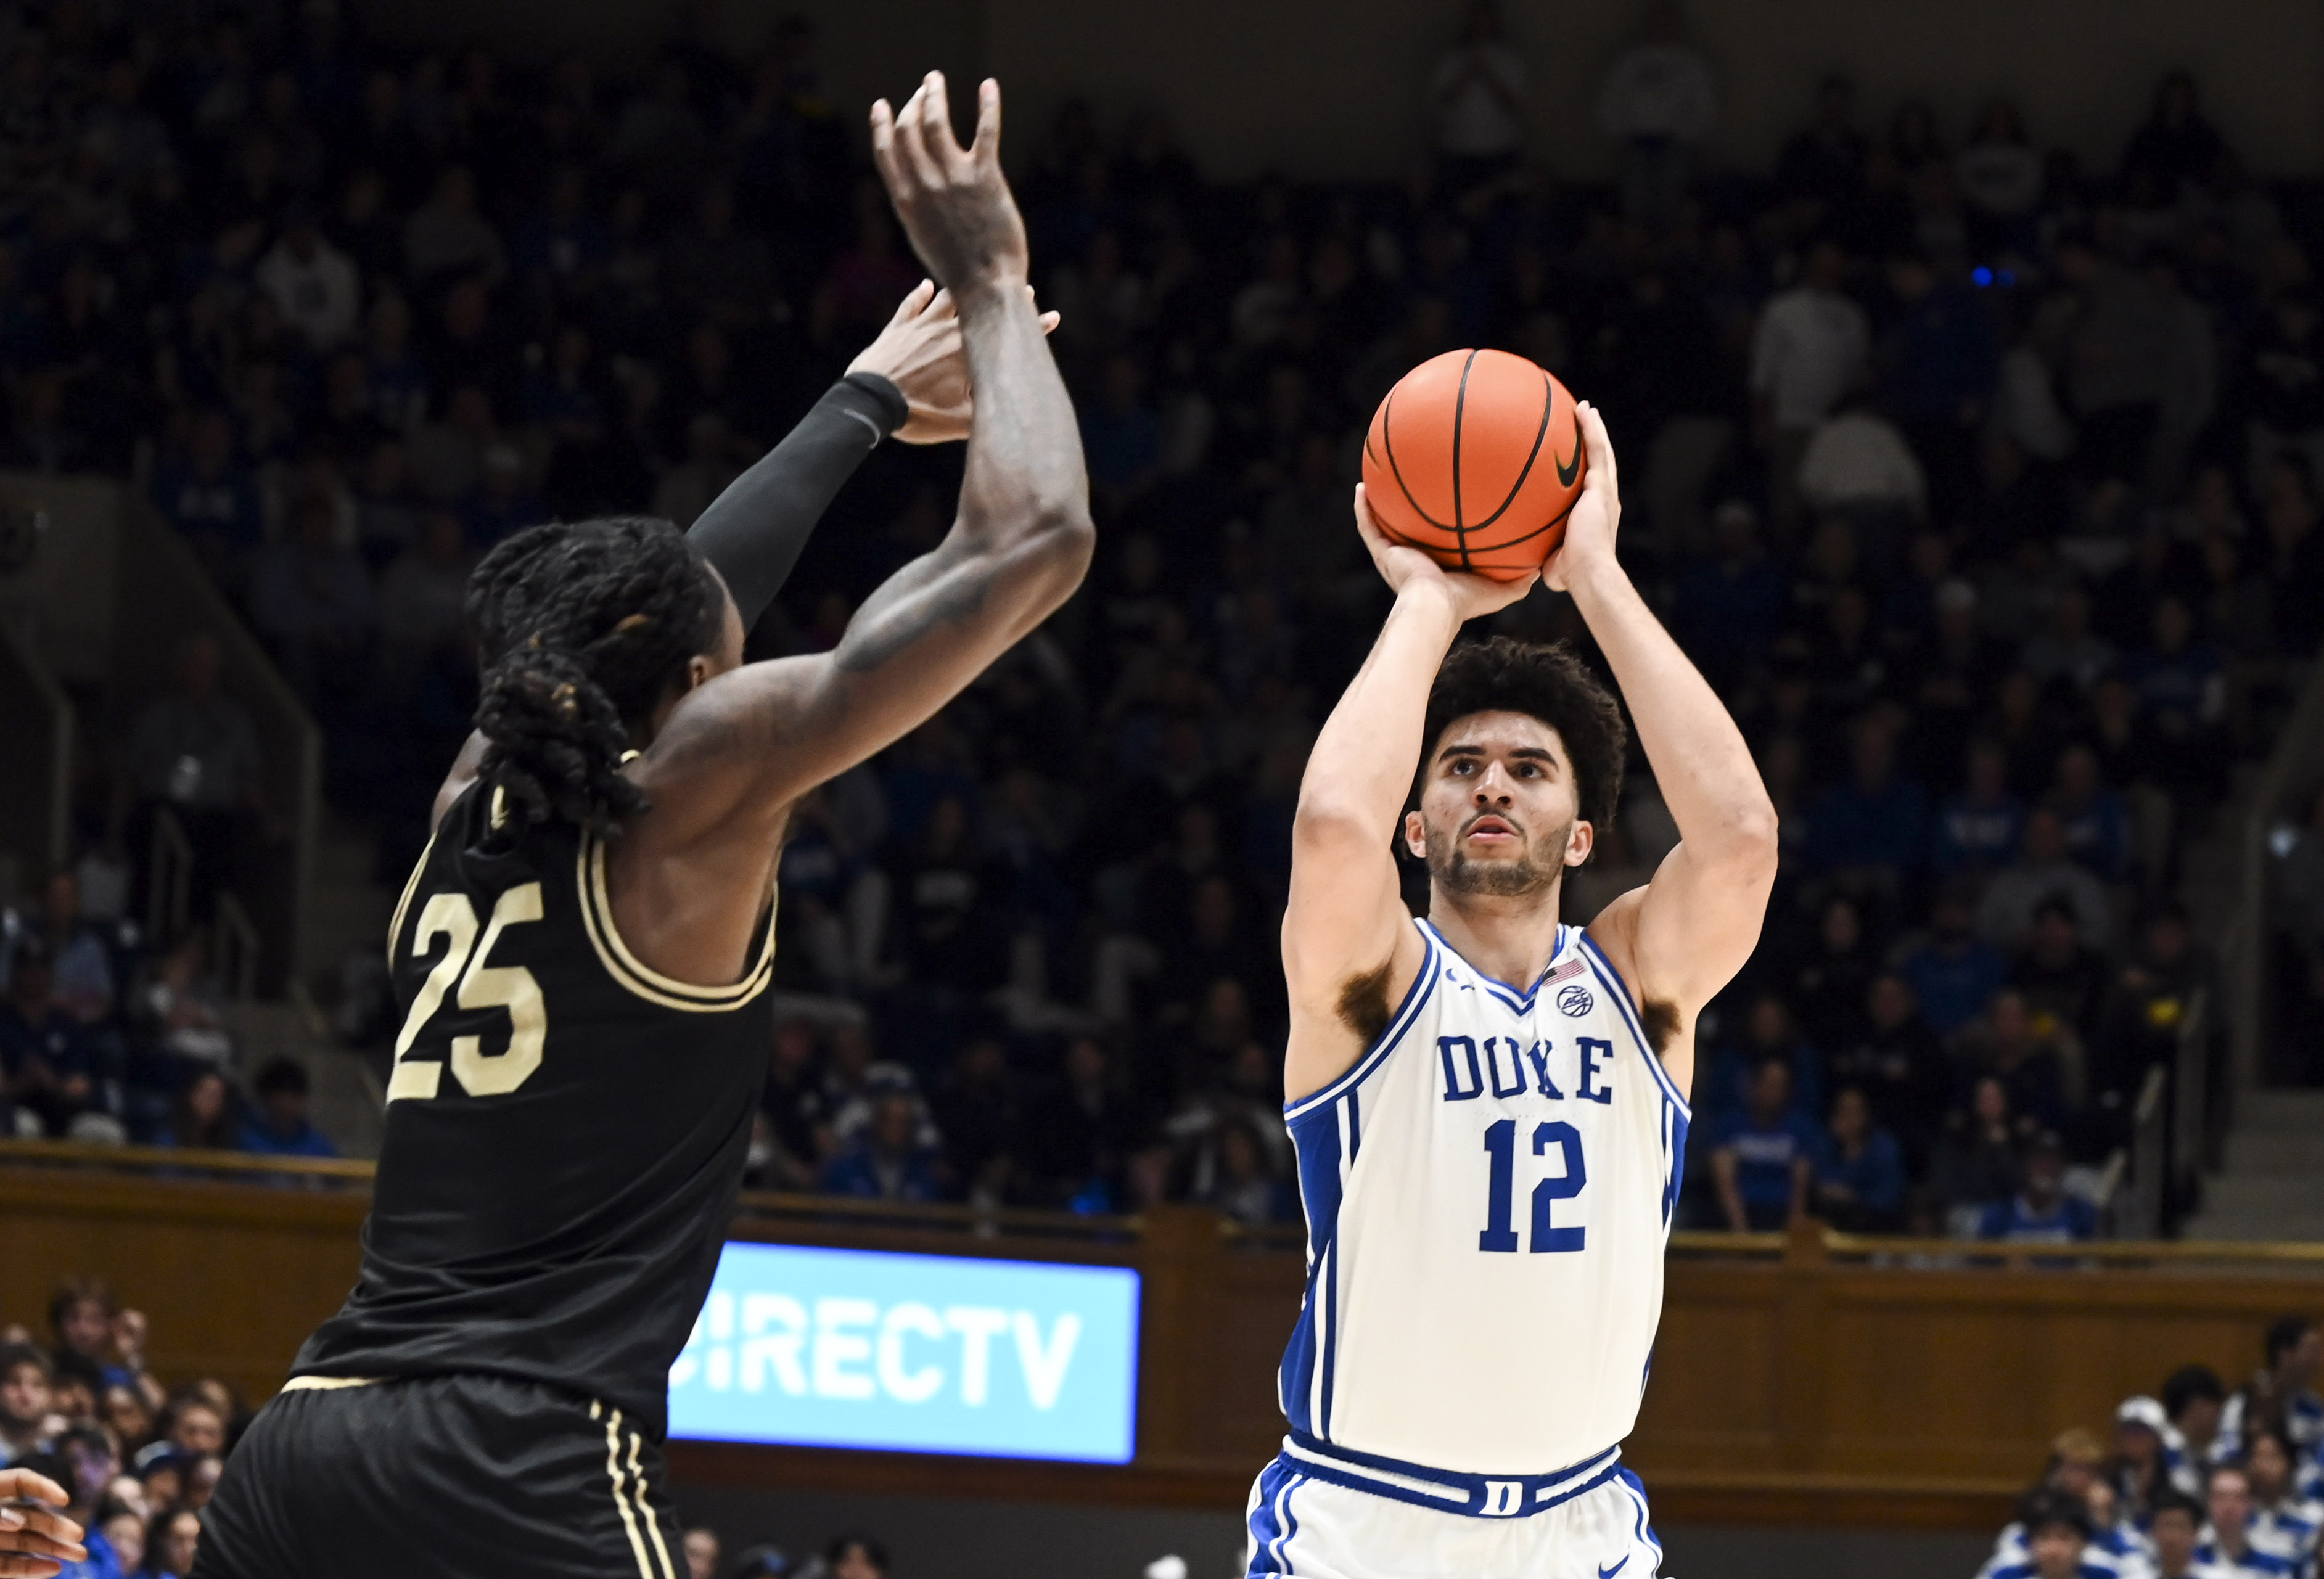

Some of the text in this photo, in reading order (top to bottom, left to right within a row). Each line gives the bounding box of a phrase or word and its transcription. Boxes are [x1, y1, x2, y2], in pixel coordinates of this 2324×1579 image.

[387, 880, 548, 1105] 25
[1562, 991, 1589, 1007] ACC
[1437, 1035, 1614, 1105] DUKE
[1479, 1120, 1587, 1253] 12
[1478, 1480, 1524, 1516] D
